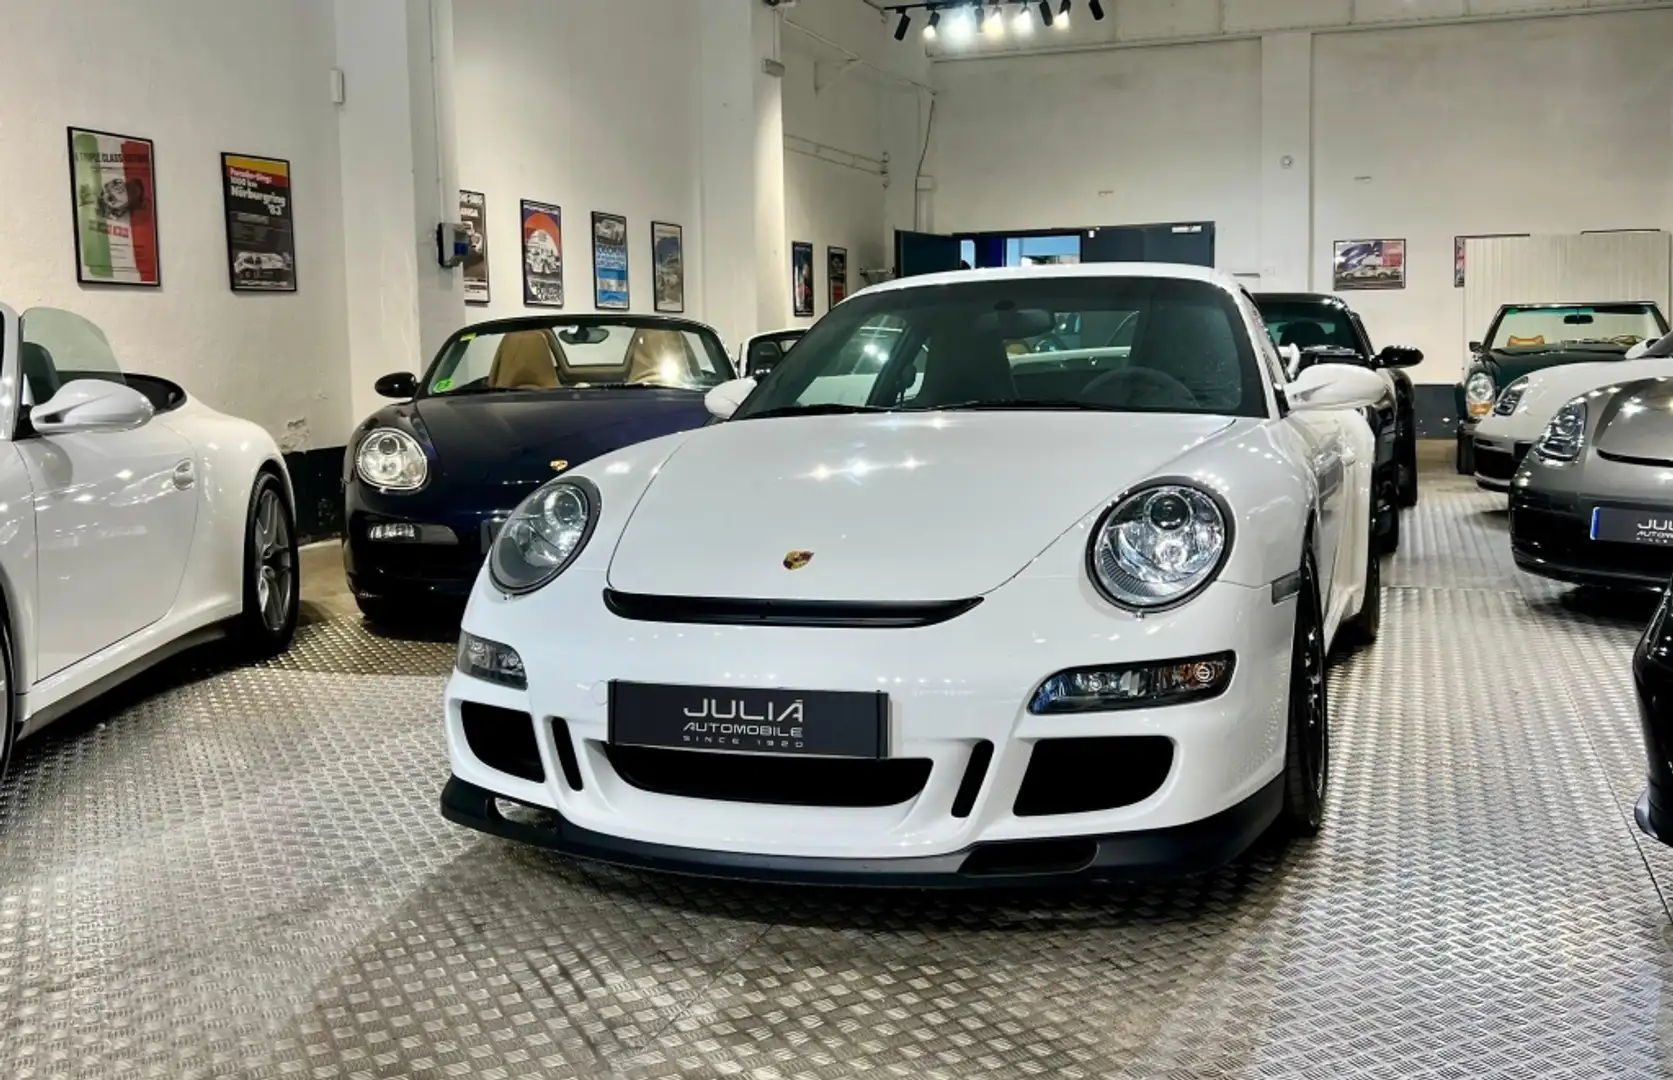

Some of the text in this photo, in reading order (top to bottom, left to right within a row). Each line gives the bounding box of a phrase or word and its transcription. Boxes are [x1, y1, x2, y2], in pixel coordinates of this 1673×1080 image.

[683, 722, 803, 738] AUTOMOBILE
[683, 735, 804, 748] SINCE 1920
